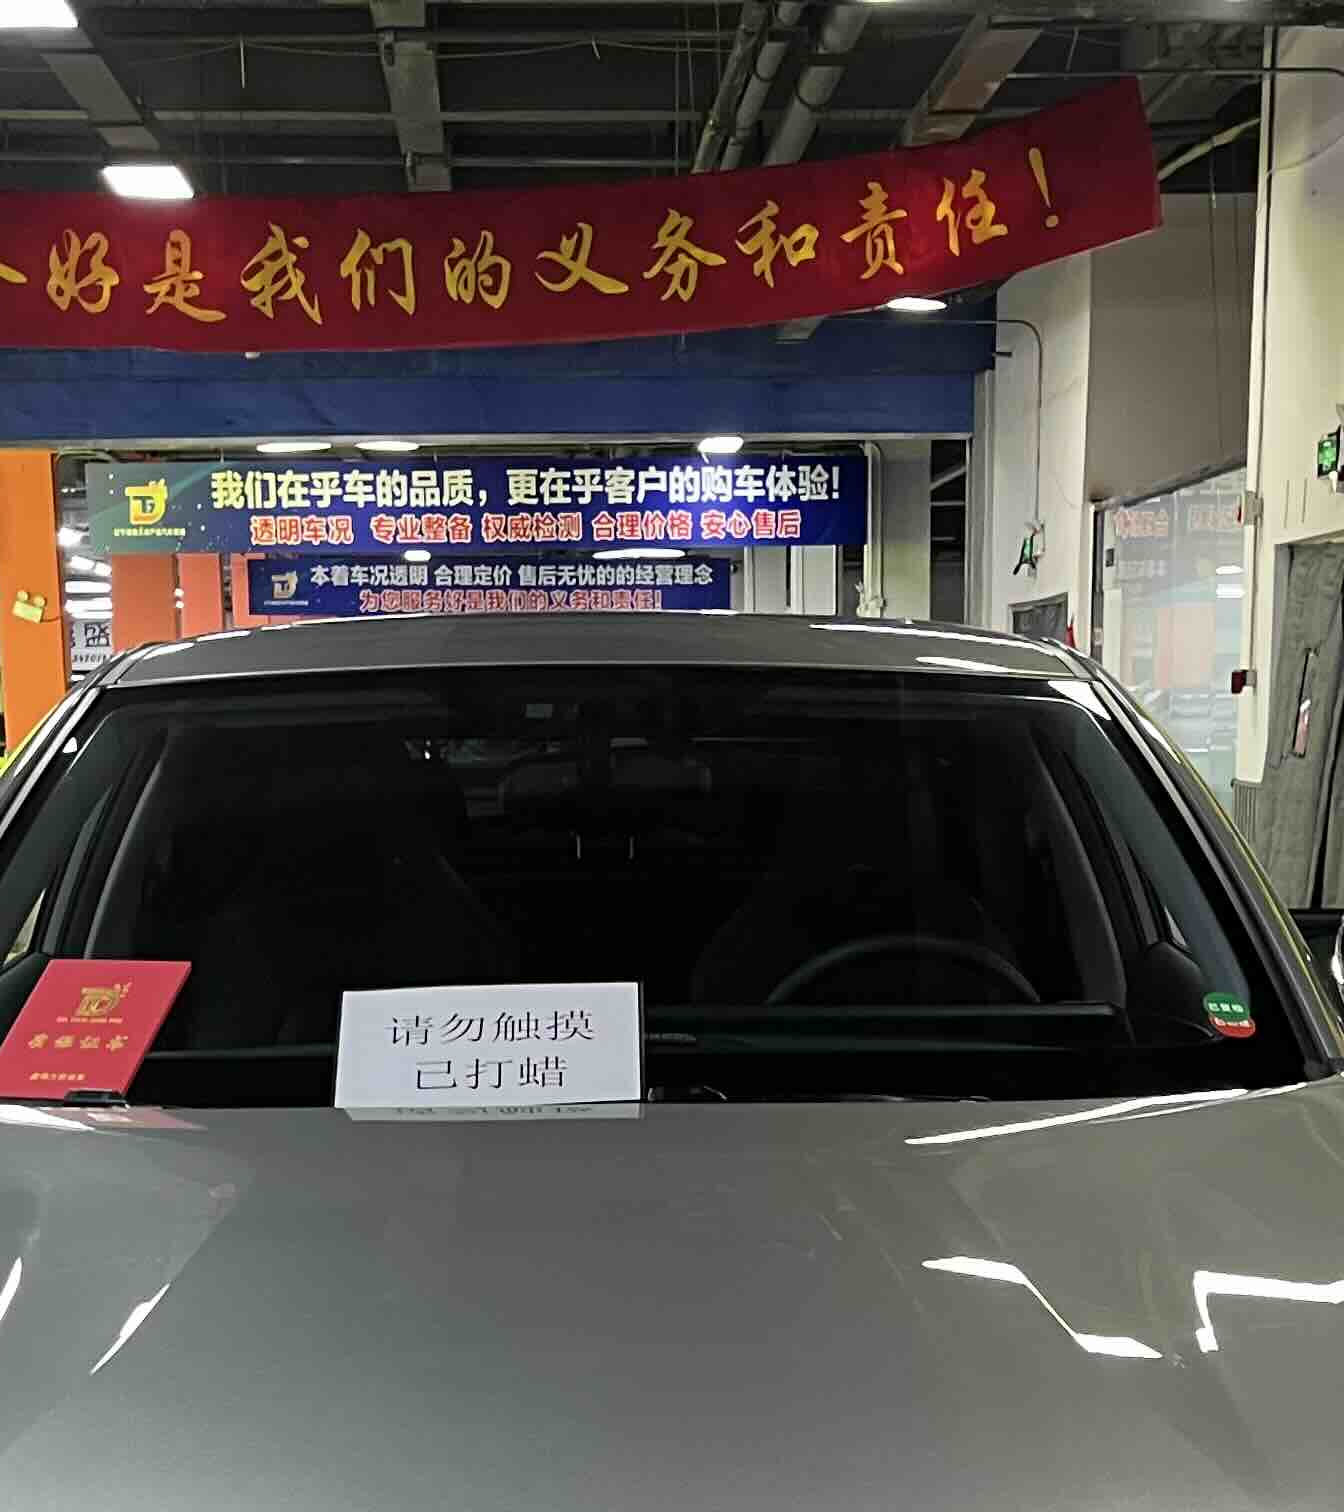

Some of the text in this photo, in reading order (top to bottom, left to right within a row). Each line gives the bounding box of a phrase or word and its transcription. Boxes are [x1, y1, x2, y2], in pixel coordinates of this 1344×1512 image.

[210, 464, 840, 509] 我们在乎车的品质，更在乎客户的购车体验！
[250, 509, 802, 545] 透明车况 专业整备 权威检测 合理价格 安心售后
[310, 564, 714, 587] 本着车况透明 合理定价 售后无忧的的经营理念
[390, 1008, 595, 1046] 请勿触摸
[413, 1056, 570, 1091] 已打蜡
